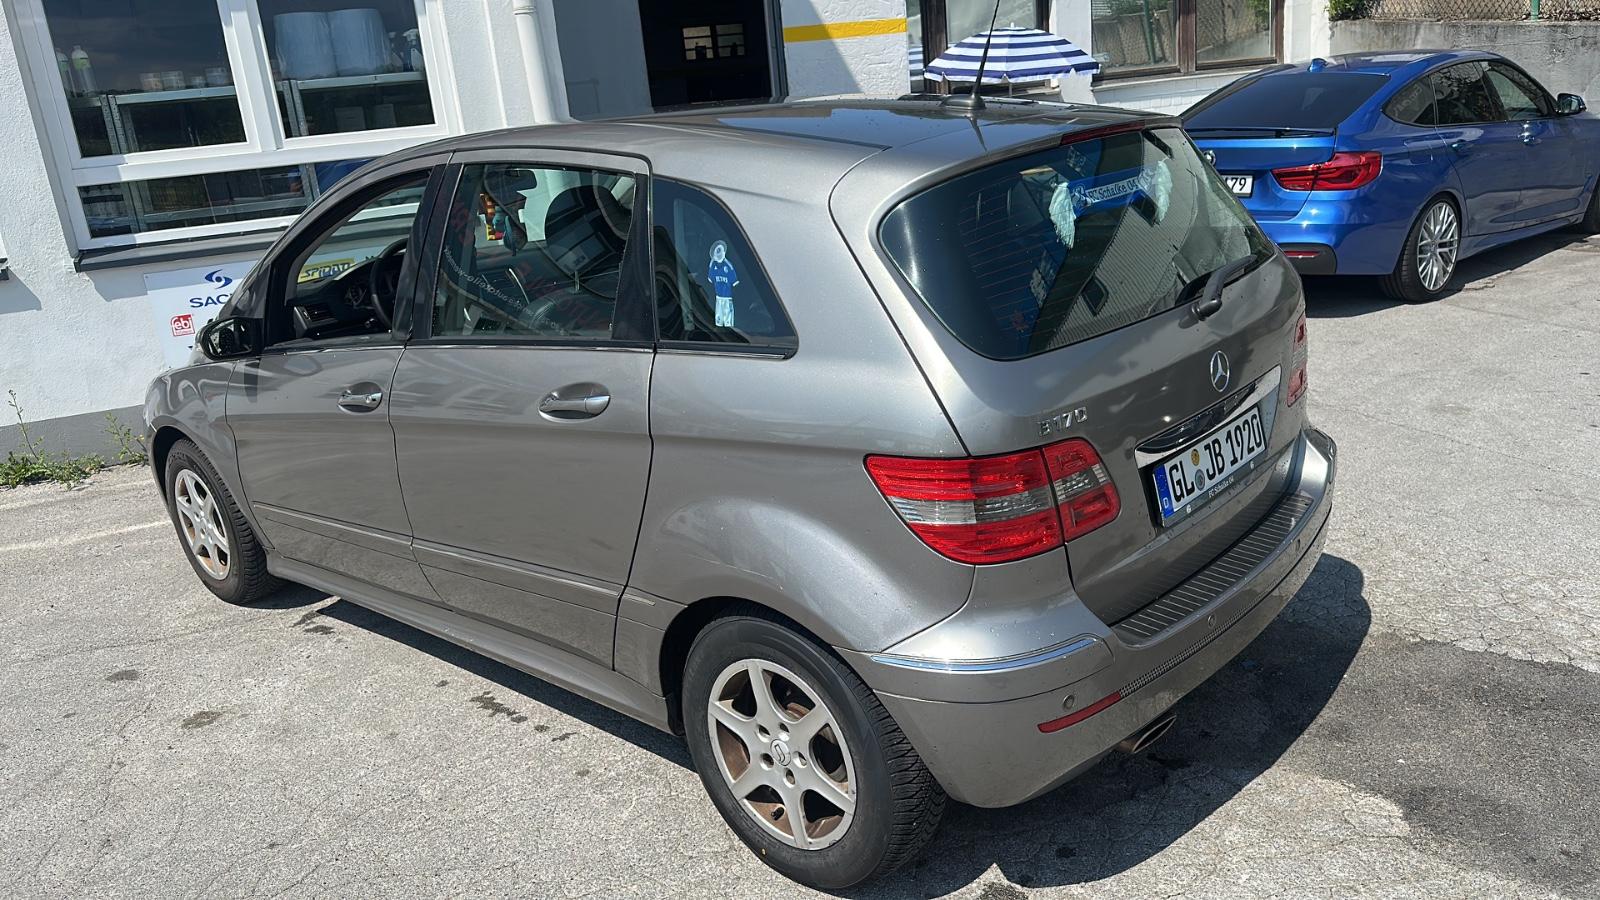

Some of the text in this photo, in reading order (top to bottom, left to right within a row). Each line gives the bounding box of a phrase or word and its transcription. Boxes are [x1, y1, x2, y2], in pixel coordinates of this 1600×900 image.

[1100, 183, 1127, 199] Schalke
[1224, 177, 1247, 191] 79
[189, 293, 233, 308] SAC
[1168, 413, 1262, 503] GL JB 1920
[1162, 497, 1169, 509] D
